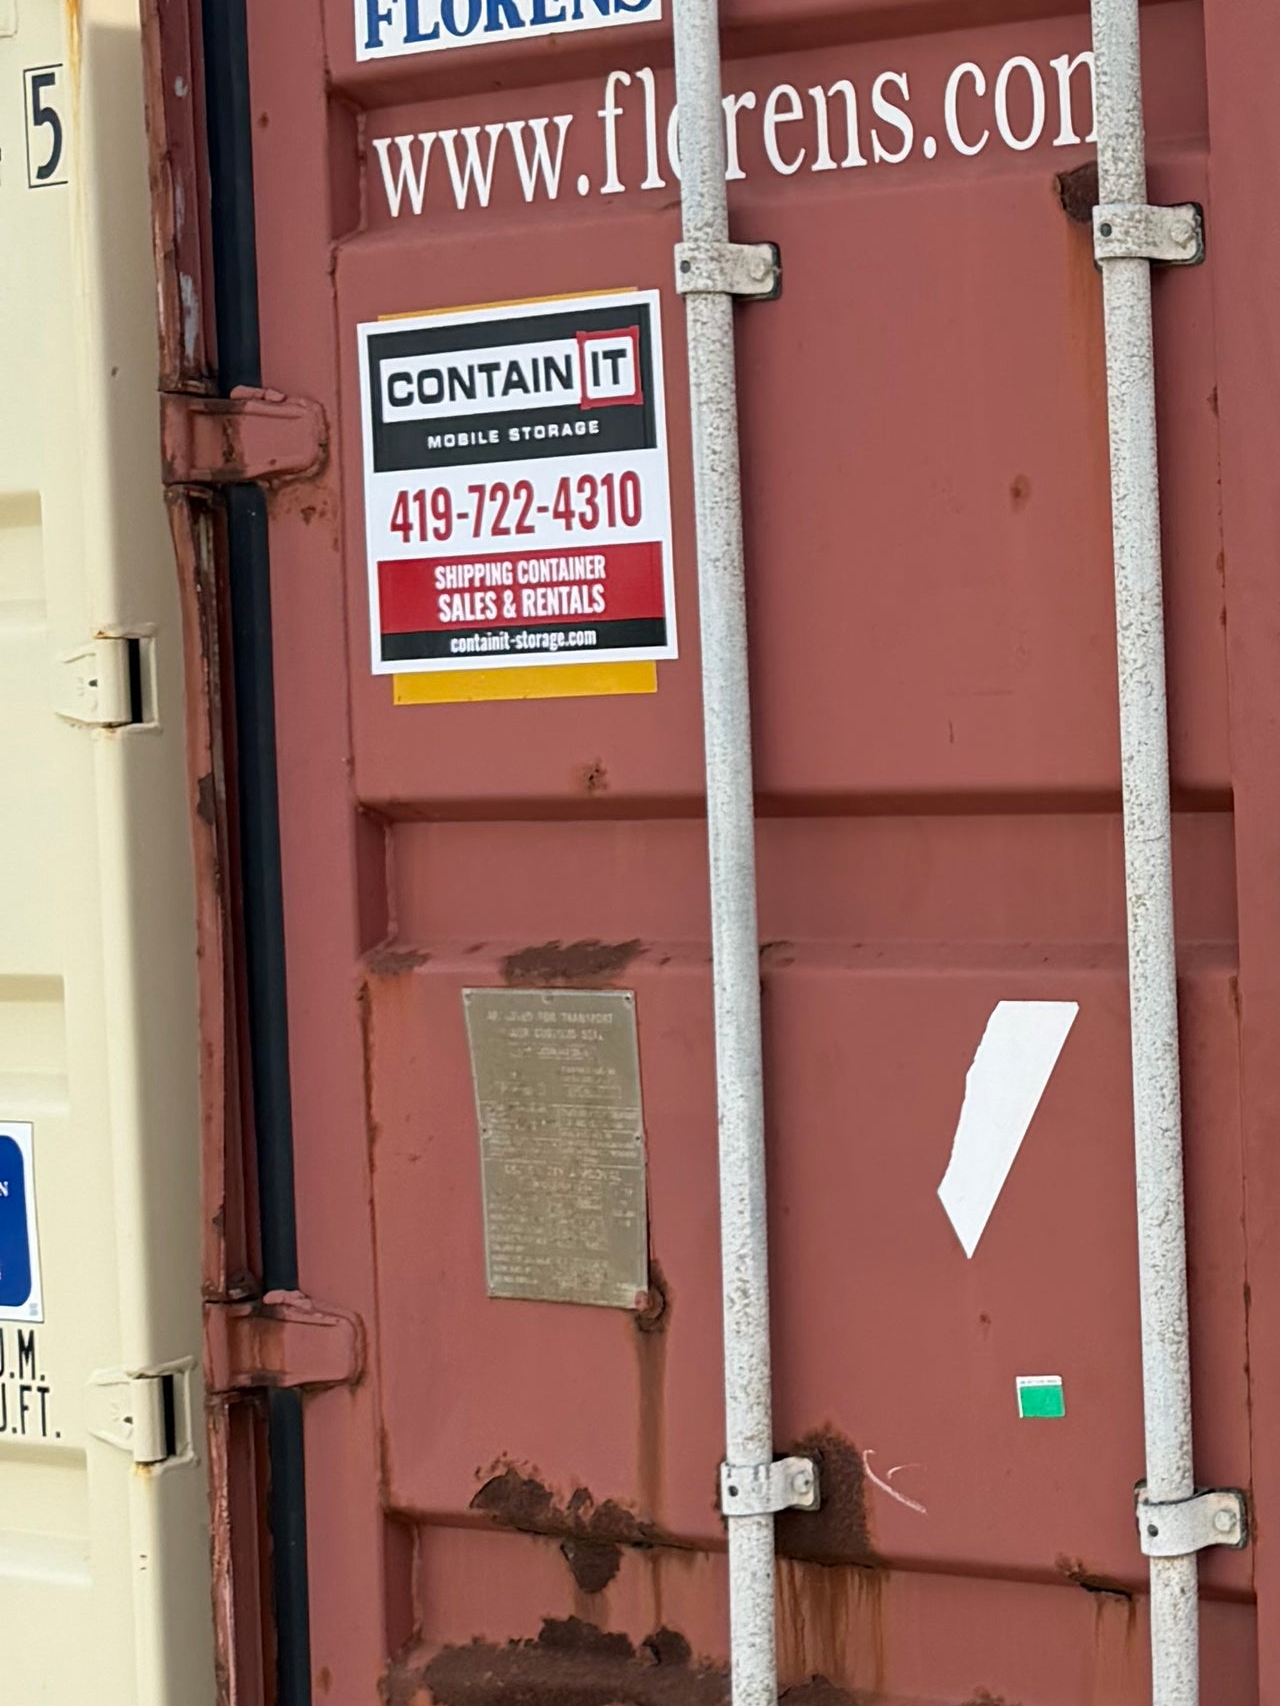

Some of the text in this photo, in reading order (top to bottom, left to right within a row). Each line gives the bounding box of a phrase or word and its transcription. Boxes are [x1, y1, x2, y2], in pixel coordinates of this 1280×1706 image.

[32, 73, 63, 180] 5
[387, 349, 626, 408] CONTAIN IT
[428, 420, 599, 448] MOBILE STORAGE
[390, 470, 642, 544] 419-722-4310
[435, 555, 605, 590] SHIPPING CONTAINER
[439, 584, 605, 622] SALES & RENTALS
[450, 628, 597, 653] containit-storage.com
